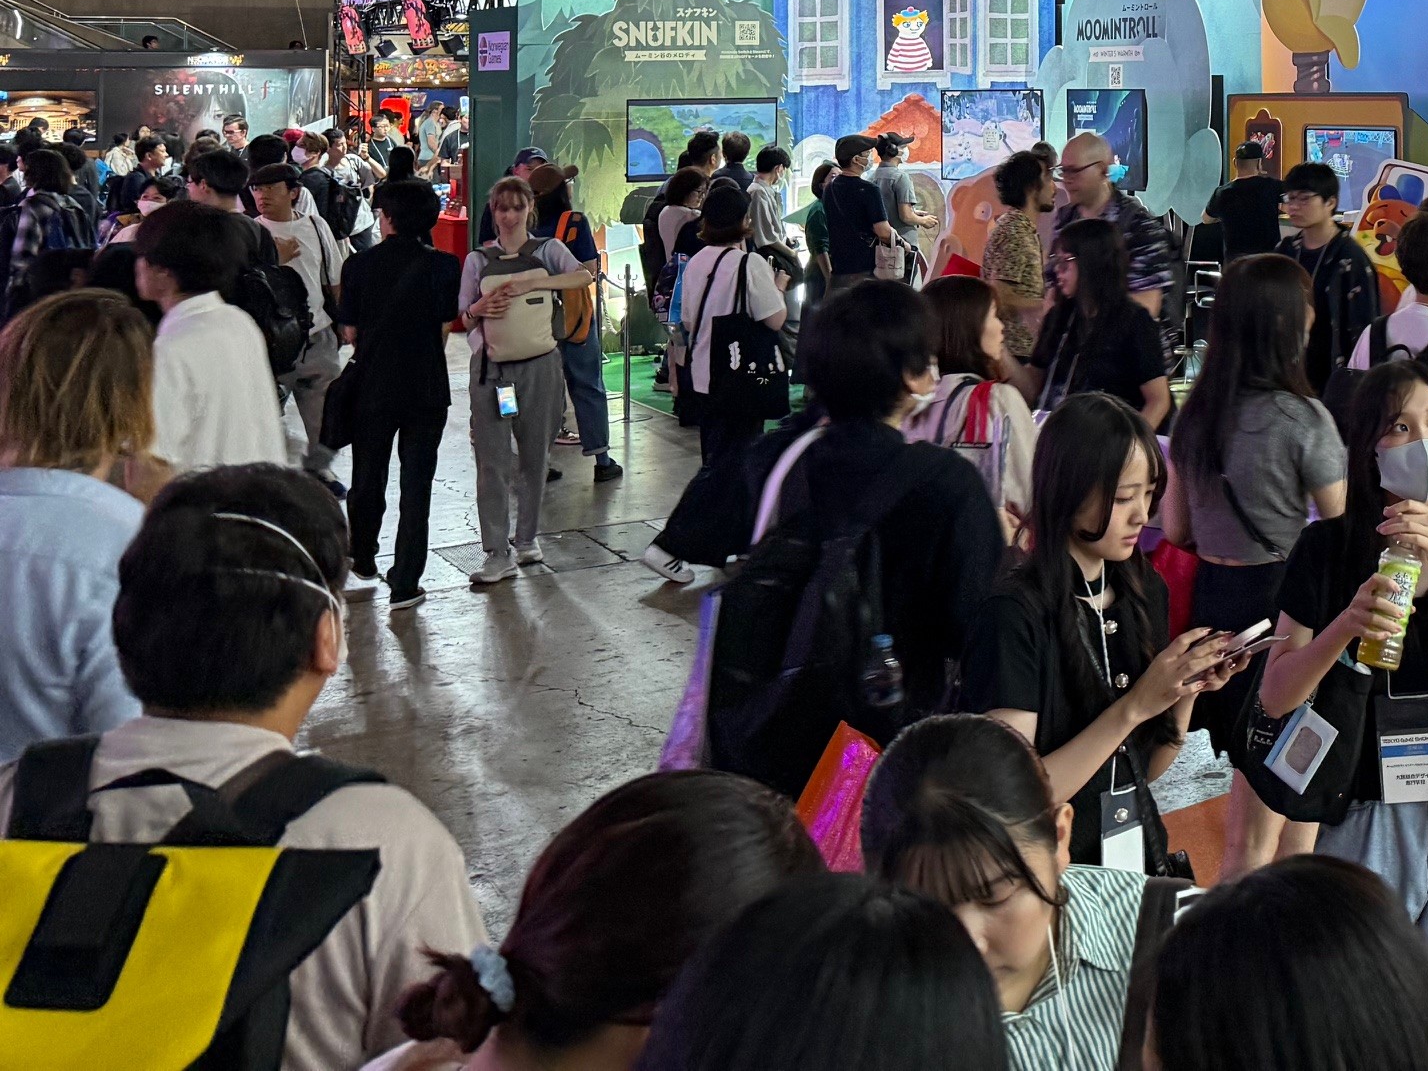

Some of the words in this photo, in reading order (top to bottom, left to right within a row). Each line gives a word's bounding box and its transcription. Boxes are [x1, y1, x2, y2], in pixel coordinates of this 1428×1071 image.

[676, 7, 718, 18] スナフキン
[1122, 2, 1158, 12] ムーミントロール
[612, 20, 718, 47] SNUFKIN
[1076, 15, 1158, 42] MOOMINTROLL
[634, 51, 696, 60] ムーミン谷のメロディ
[154, 83, 215, 96] SILENT
[219, 83, 256, 95] HILL
